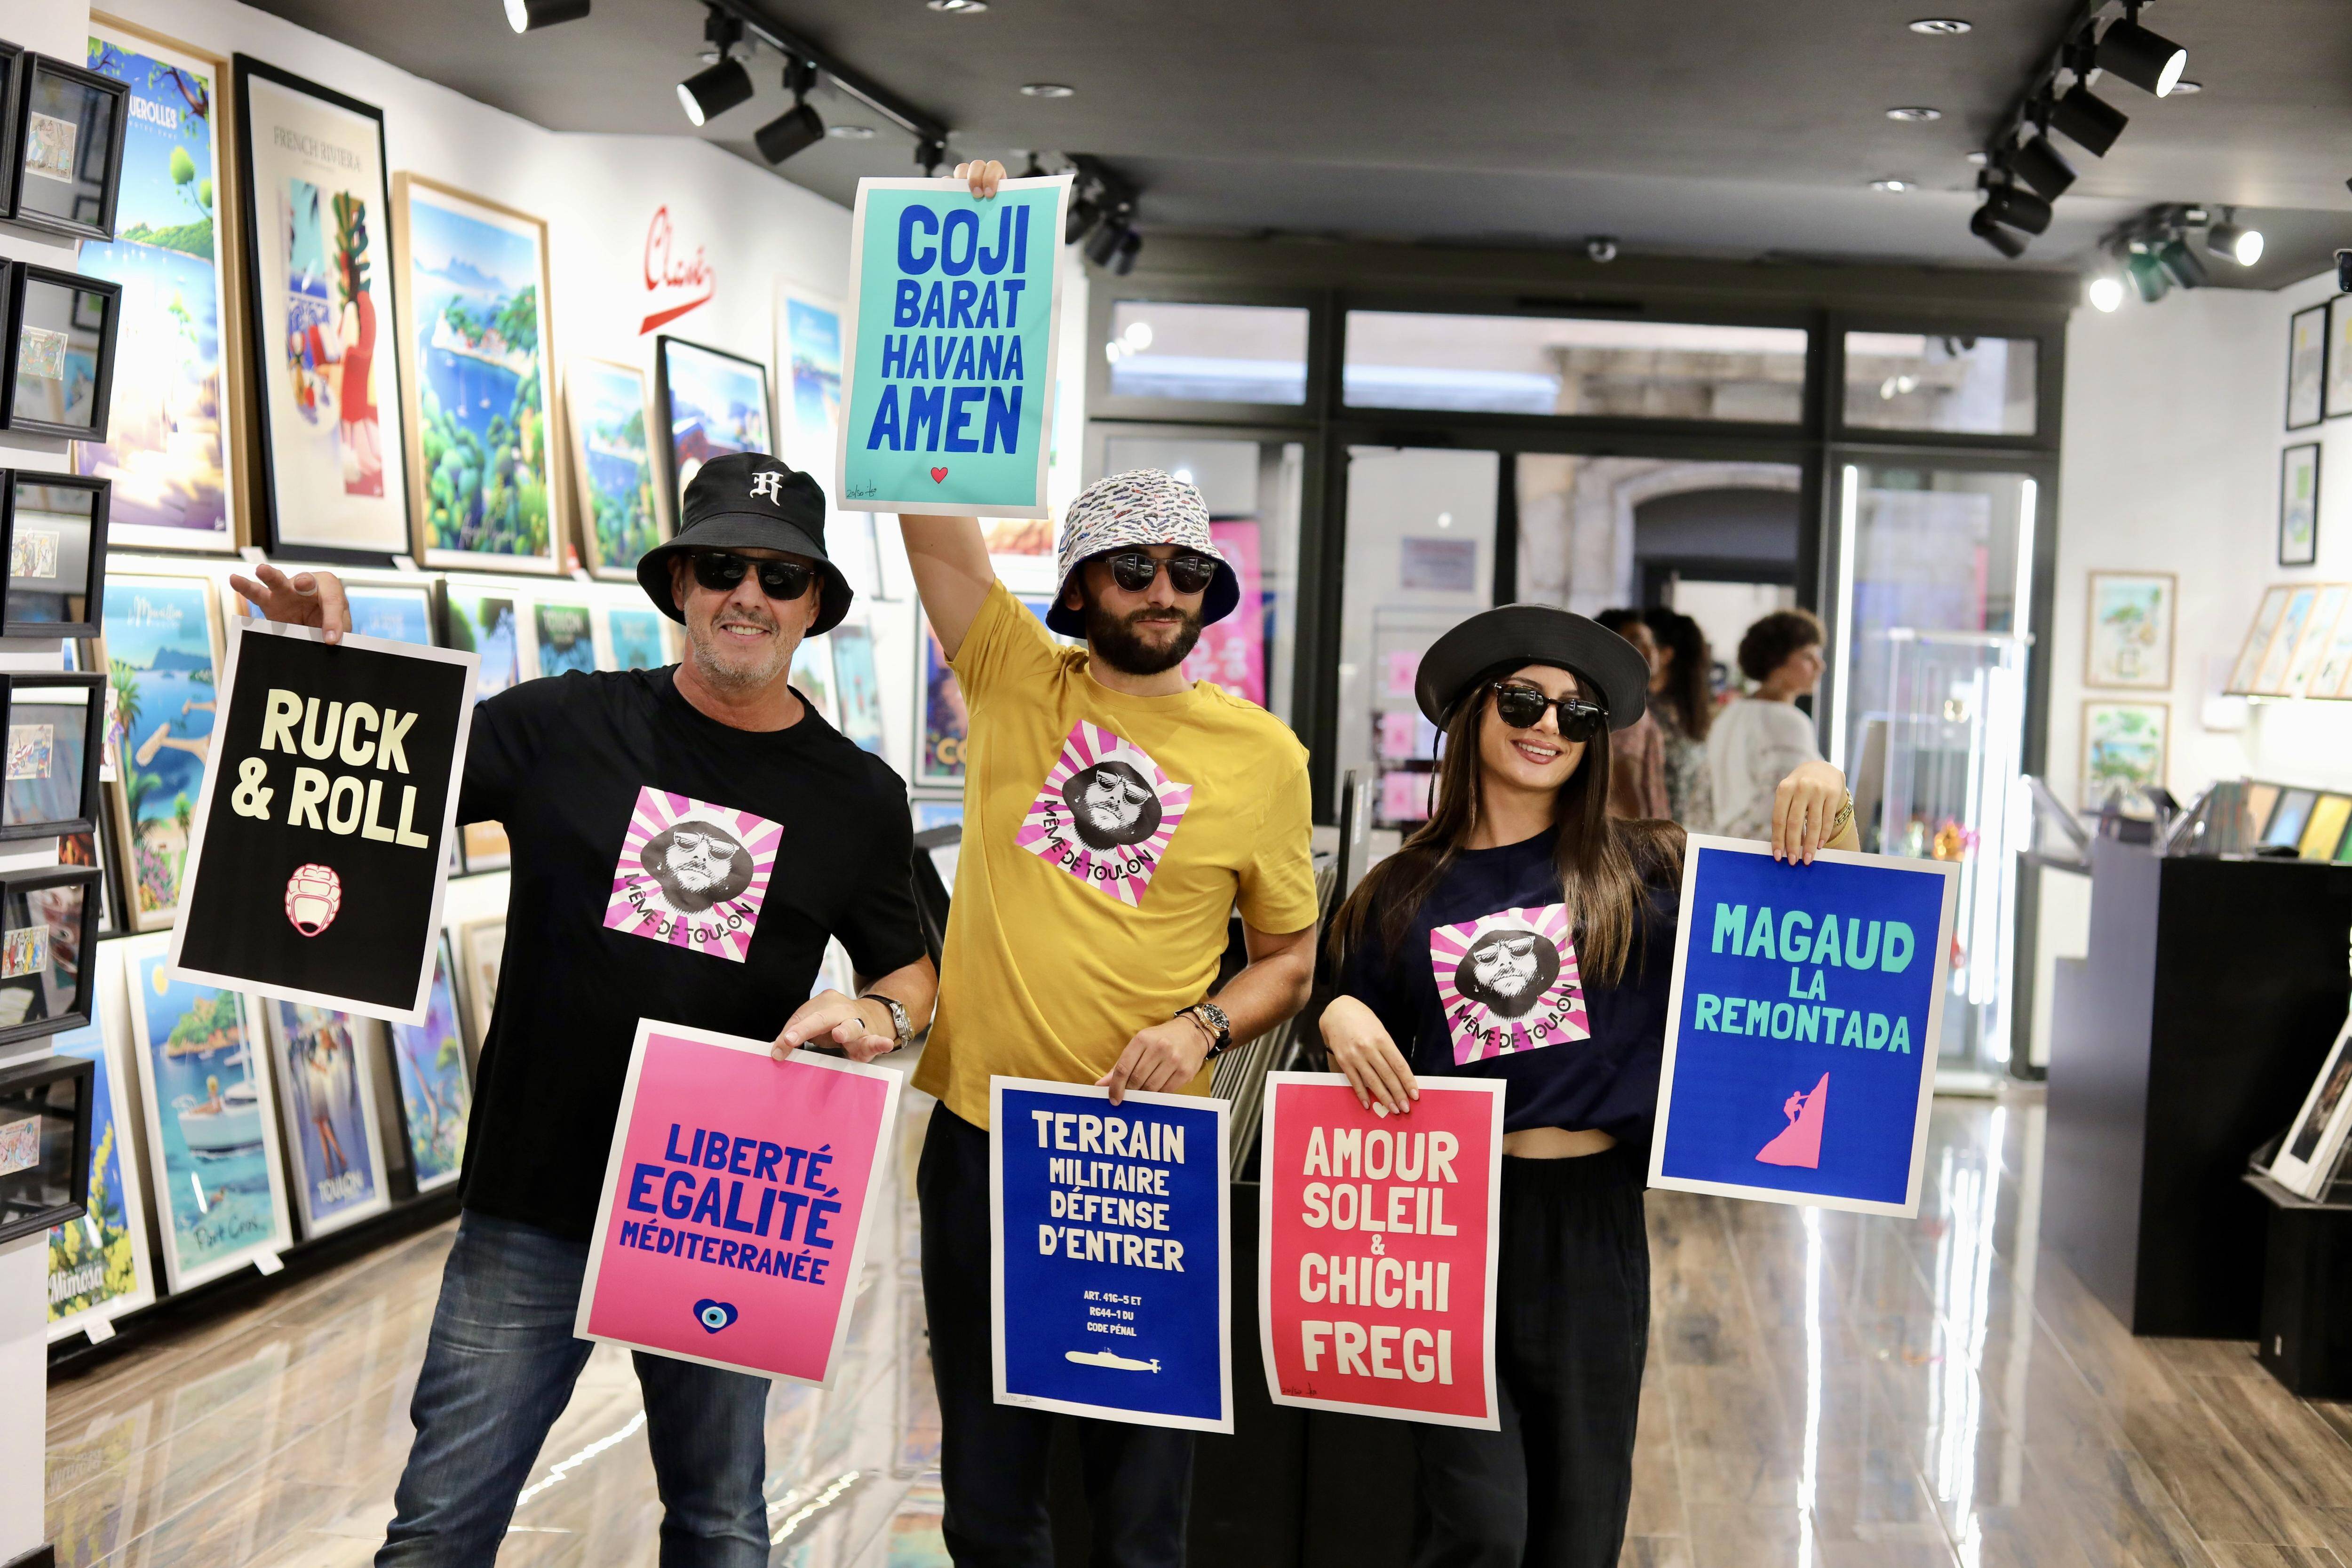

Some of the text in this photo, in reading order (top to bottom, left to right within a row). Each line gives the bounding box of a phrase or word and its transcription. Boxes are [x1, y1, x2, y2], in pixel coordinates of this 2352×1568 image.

[273, 125, 317, 158] FRENCH
[320, 142, 362, 172] RIVIERA
[897, 204, 1030, 277] COJI
[893, 279, 1026, 329] BARAT
[881, 334, 1024, 381] HAVANA
[866, 384, 1023, 454] AMEN
[260, 689, 419, 774] RUCK
[231, 757, 429, 849] & ROLL
[1043, 800, 1154, 881] MÊME DE TOULON
[624, 873, 755, 944] MÊME DE TOULON
[1711, 903, 1915, 973] MAGAUD
[1788, 967, 1826, 1001] LA
[1454, 983, 1577, 1049] MÊME DE TOULON
[1694, 993, 1910, 1054] REMONTADA
[664, 1123, 833, 1192] LIBERTÉ
[1032, 1110, 1184, 1164] TERRAIN
[1303, 1126, 1459, 1183] AMOUR
[317, 1170, 364, 1203] TOULON
[1049, 1157, 1169, 1196] MILITAIRE
[627, 1162, 842, 1250] EGALITÉ
[1050, 1186, 1169, 1231] DÉFENSE
[1302, 1182, 1457, 1236] SOLEIL
[619, 1216, 830, 1286] MÉDITERRANÉE
[1039, 1224, 1185, 1272] D'ENTRER
[1371, 1234, 1385, 1256] &
[48, 1266, 103, 1303] Mimosa
[1084, 1290, 1102, 1301] ART.
[1131, 1296, 1142, 1306] ET
[1300, 1252, 1450, 1312] CHICHI
[1087, 1321, 1137, 1337] CODE PÉNAL
[1122, 1311, 1134, 1321] DU
[1301, 1320, 1453, 1385] FREGI
